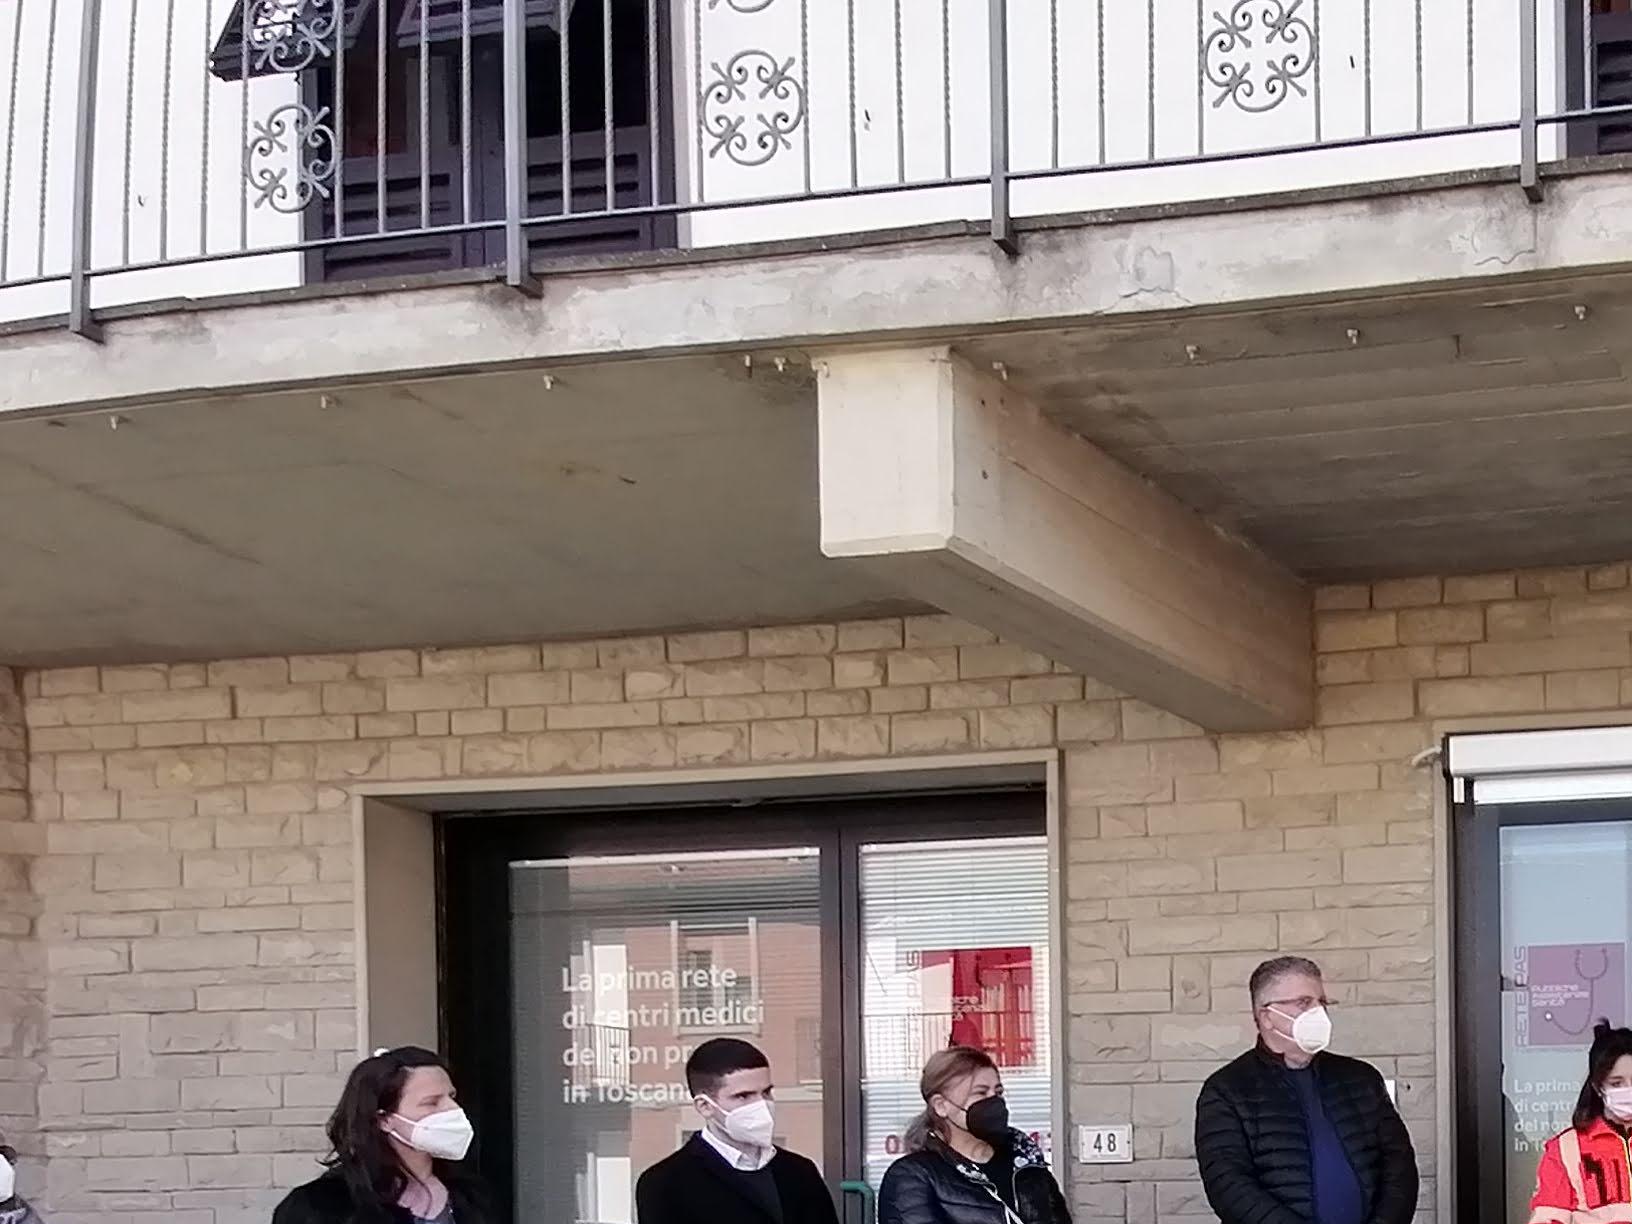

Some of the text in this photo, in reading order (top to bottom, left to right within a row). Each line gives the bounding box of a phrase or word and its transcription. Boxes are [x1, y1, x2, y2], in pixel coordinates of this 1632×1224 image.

[561, 963, 737, 995] La prima rete
[562, 999, 765, 1029] di centri medici
[563, 1078, 697, 1103] in Toscan
[1514, 1079, 1533, 1094] La
[1514, 1098, 1575, 1113] di centr
[1093, 1132, 1117, 1153] 48
